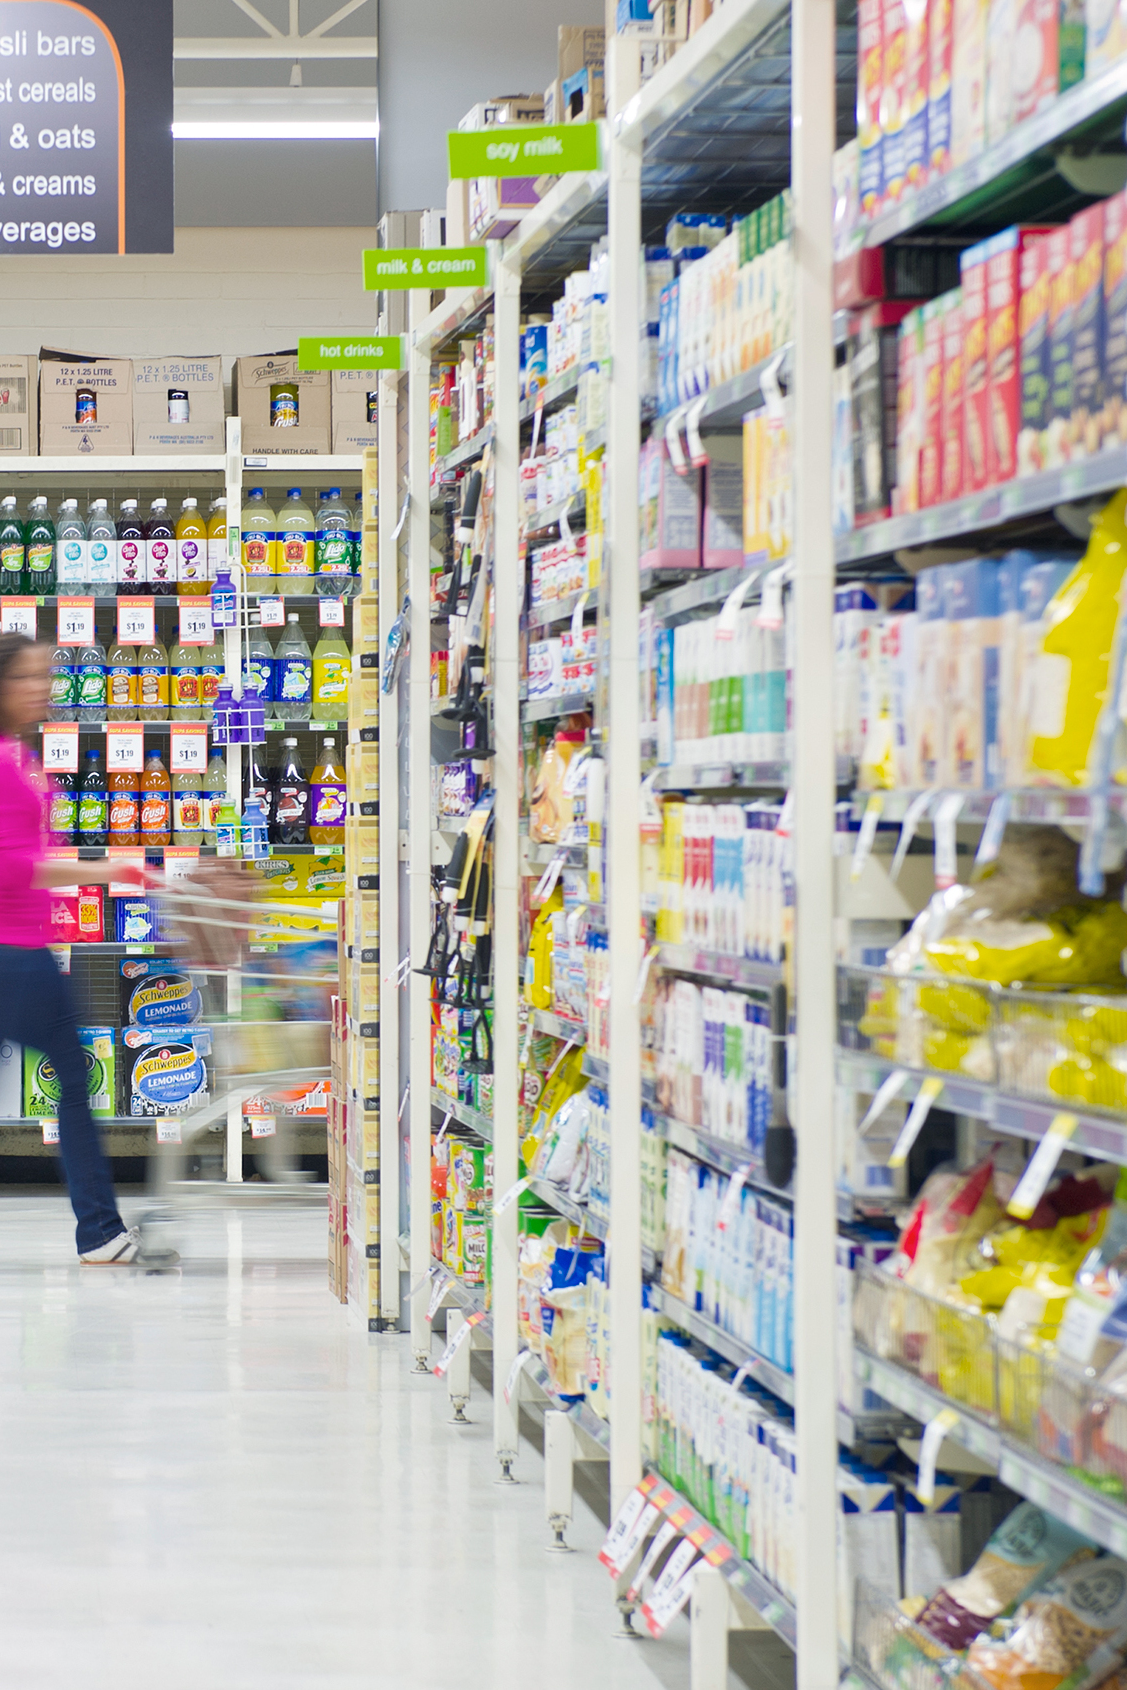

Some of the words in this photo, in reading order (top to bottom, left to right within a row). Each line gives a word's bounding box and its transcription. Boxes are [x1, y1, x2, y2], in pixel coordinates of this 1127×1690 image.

[37, 30, 96, 56] bars
[19, 76, 96, 103] cereals
[9, 123, 30, 149] &
[38, 124, 96, 149] oats
[486, 141, 520, 163] soy
[523, 136, 563, 157] milk
[12, 175, 96, 196] creams
[376, 259, 408, 276] milk
[411, 257, 424, 275] &
[427, 258, 476, 274] cream
[319, 344, 342, 358] hot
[344, 343, 384, 358] drinks
[93, 368, 113, 376] LITRE
[163, 365, 180, 373] 1.25
[183, 364, 208, 372] LITRE
[256, 364, 287, 377] Schweppes
[137, 374, 160, 383] P.E.T.
[172, 373, 214, 382] BOTTLES
[340, 371, 363, 379] P.E.T.
[56, 378, 75, 386] P.E.T.
[66, 622, 85, 632] $1.19
[127, 622, 145, 632] $1.19
[187, 621, 206, 632] $1.19
[84, 678, 102, 694] Lido
[51, 749, 69, 759] $1.19
[116, 749, 134, 759] $1.19
[179, 750, 197, 760] $1.19
[80, 805, 102, 822] Crush
[111, 805, 134, 823] Crush
[142, 805, 166, 823] Crush
[51, 901, 69, 912] LA
[51, 912, 77, 924] ICE
[138, 984, 189, 1005] Schweppes
[144, 1000, 193, 1018] LEMONADE
[142, 1055, 192, 1075] Schweppes
[147, 1070, 197, 1088] LEMONADE
[30, 1096, 46, 1106] 24
[132, 1097, 142, 1105] 24
[245, 1096, 262, 1105] 24
